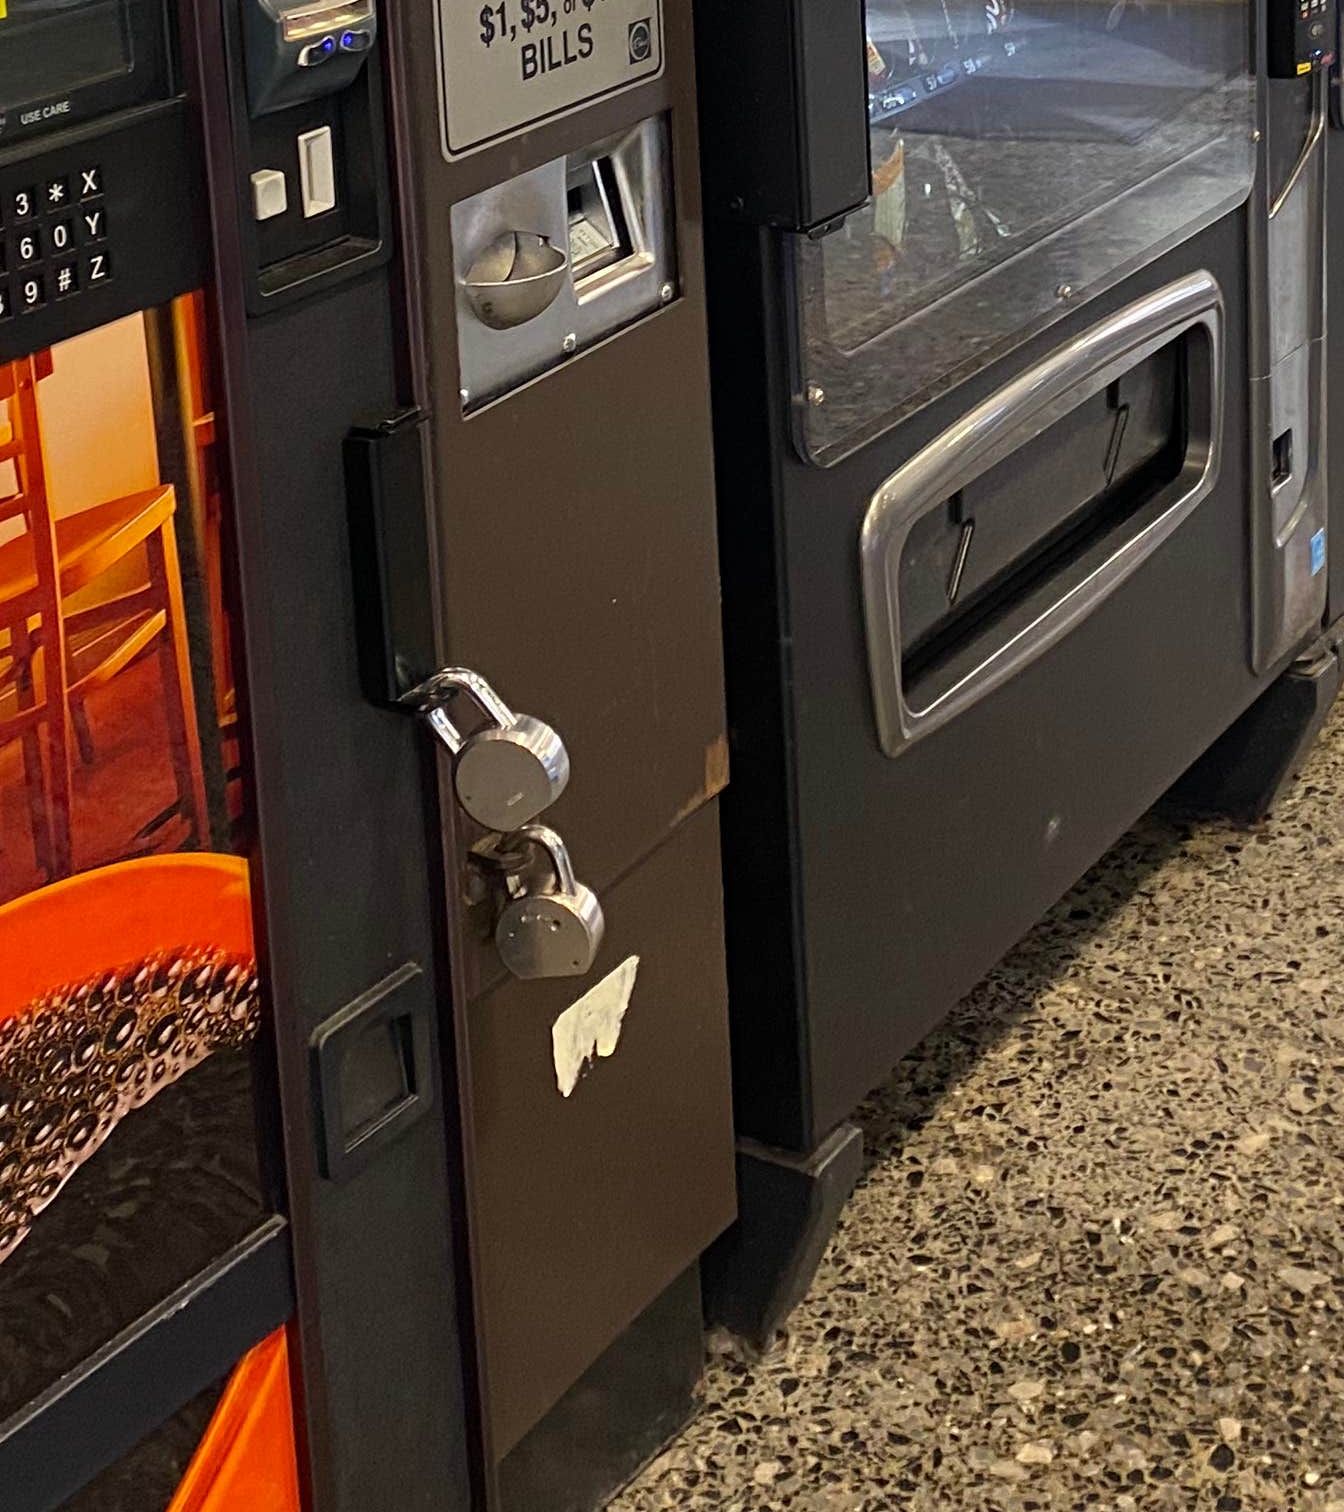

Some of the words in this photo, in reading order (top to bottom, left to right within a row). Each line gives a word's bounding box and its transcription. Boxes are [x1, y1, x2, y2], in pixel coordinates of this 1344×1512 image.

[479, 0, 517, 48] $1,
[521, 23, 594, 81] BILLS
[20, 111, 41, 126] USE
[43, 100, 71, 120] CARE
[15, 193, 29, 216] 3
[81, 169, 97, 194] X
[20, 237, 34, 259] 6
[54, 225, 67, 248] 0
[85, 212, 100, 236] Y
[24, 281, 38, 304] 9
[58, 268, 71, 292] #
[91, 256, 105, 280] Z
